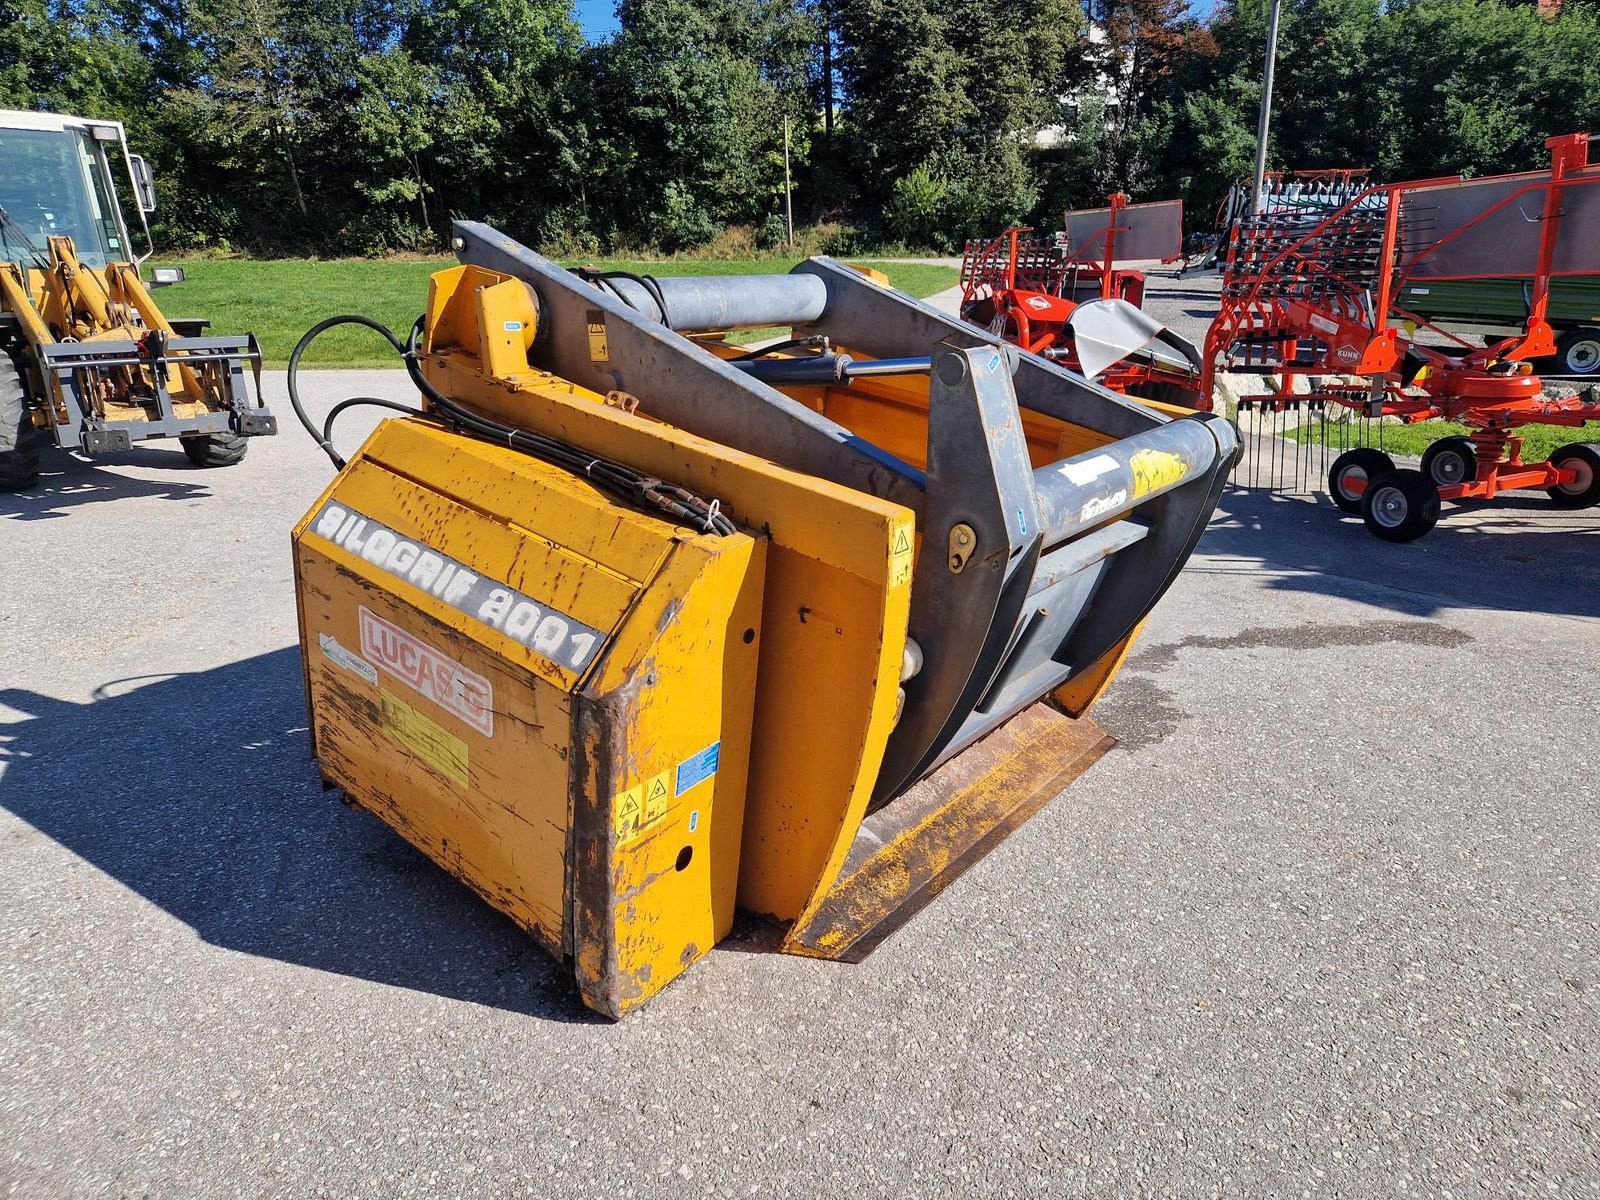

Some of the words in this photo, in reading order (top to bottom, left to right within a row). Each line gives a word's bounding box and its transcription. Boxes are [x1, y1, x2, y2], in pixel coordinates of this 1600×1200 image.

[1337, 349, 1359, 360] KUHN
[317, 506, 478, 607] SILOGRIF
[478, 588, 597, 667] 2001
[367, 621, 454, 701] LUCAS
